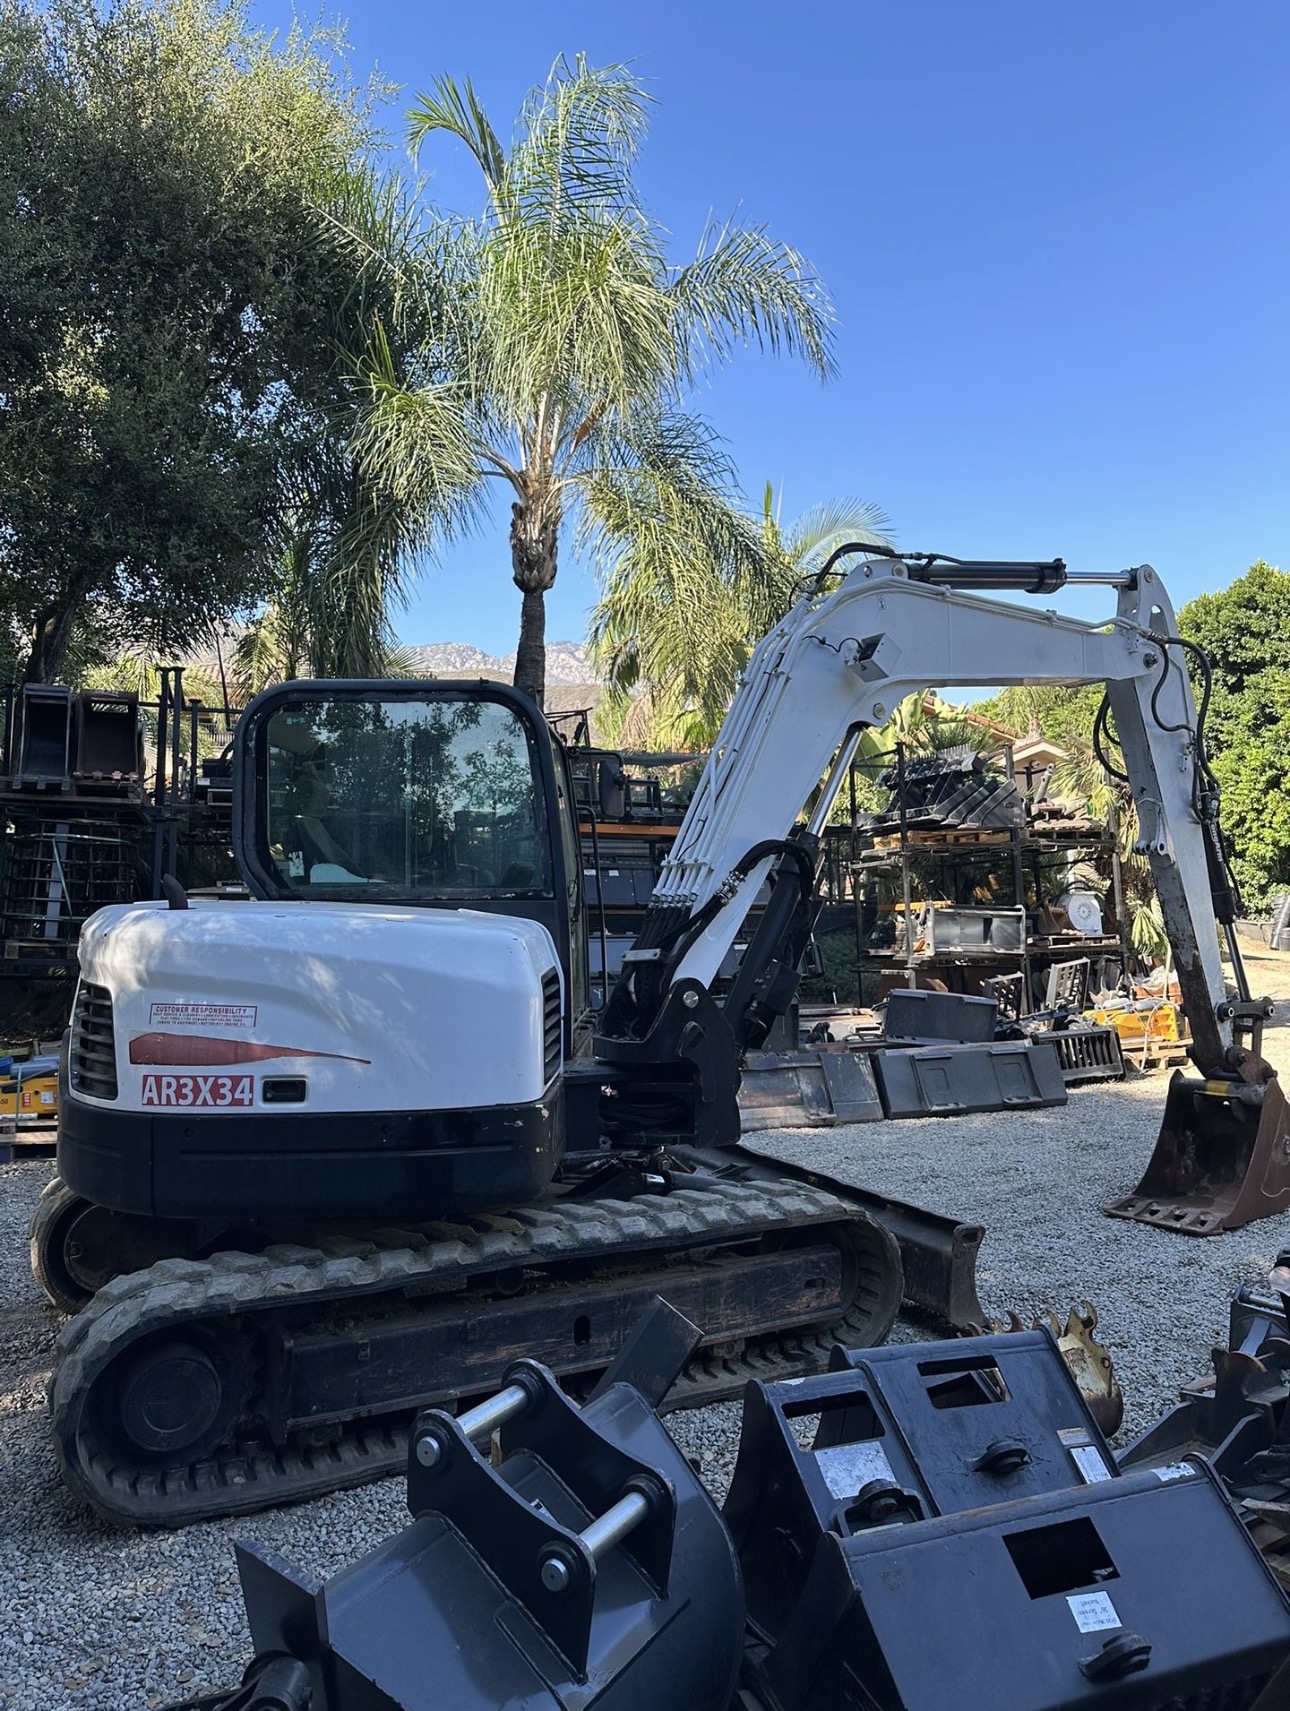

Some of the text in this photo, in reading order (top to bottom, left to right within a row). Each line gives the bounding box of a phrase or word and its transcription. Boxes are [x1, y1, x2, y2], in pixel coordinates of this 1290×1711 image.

[155, 1005, 247, 1014] CUSTOMER RESPONSIBILITY
[142, 1076, 252, 1106] AR3X34
